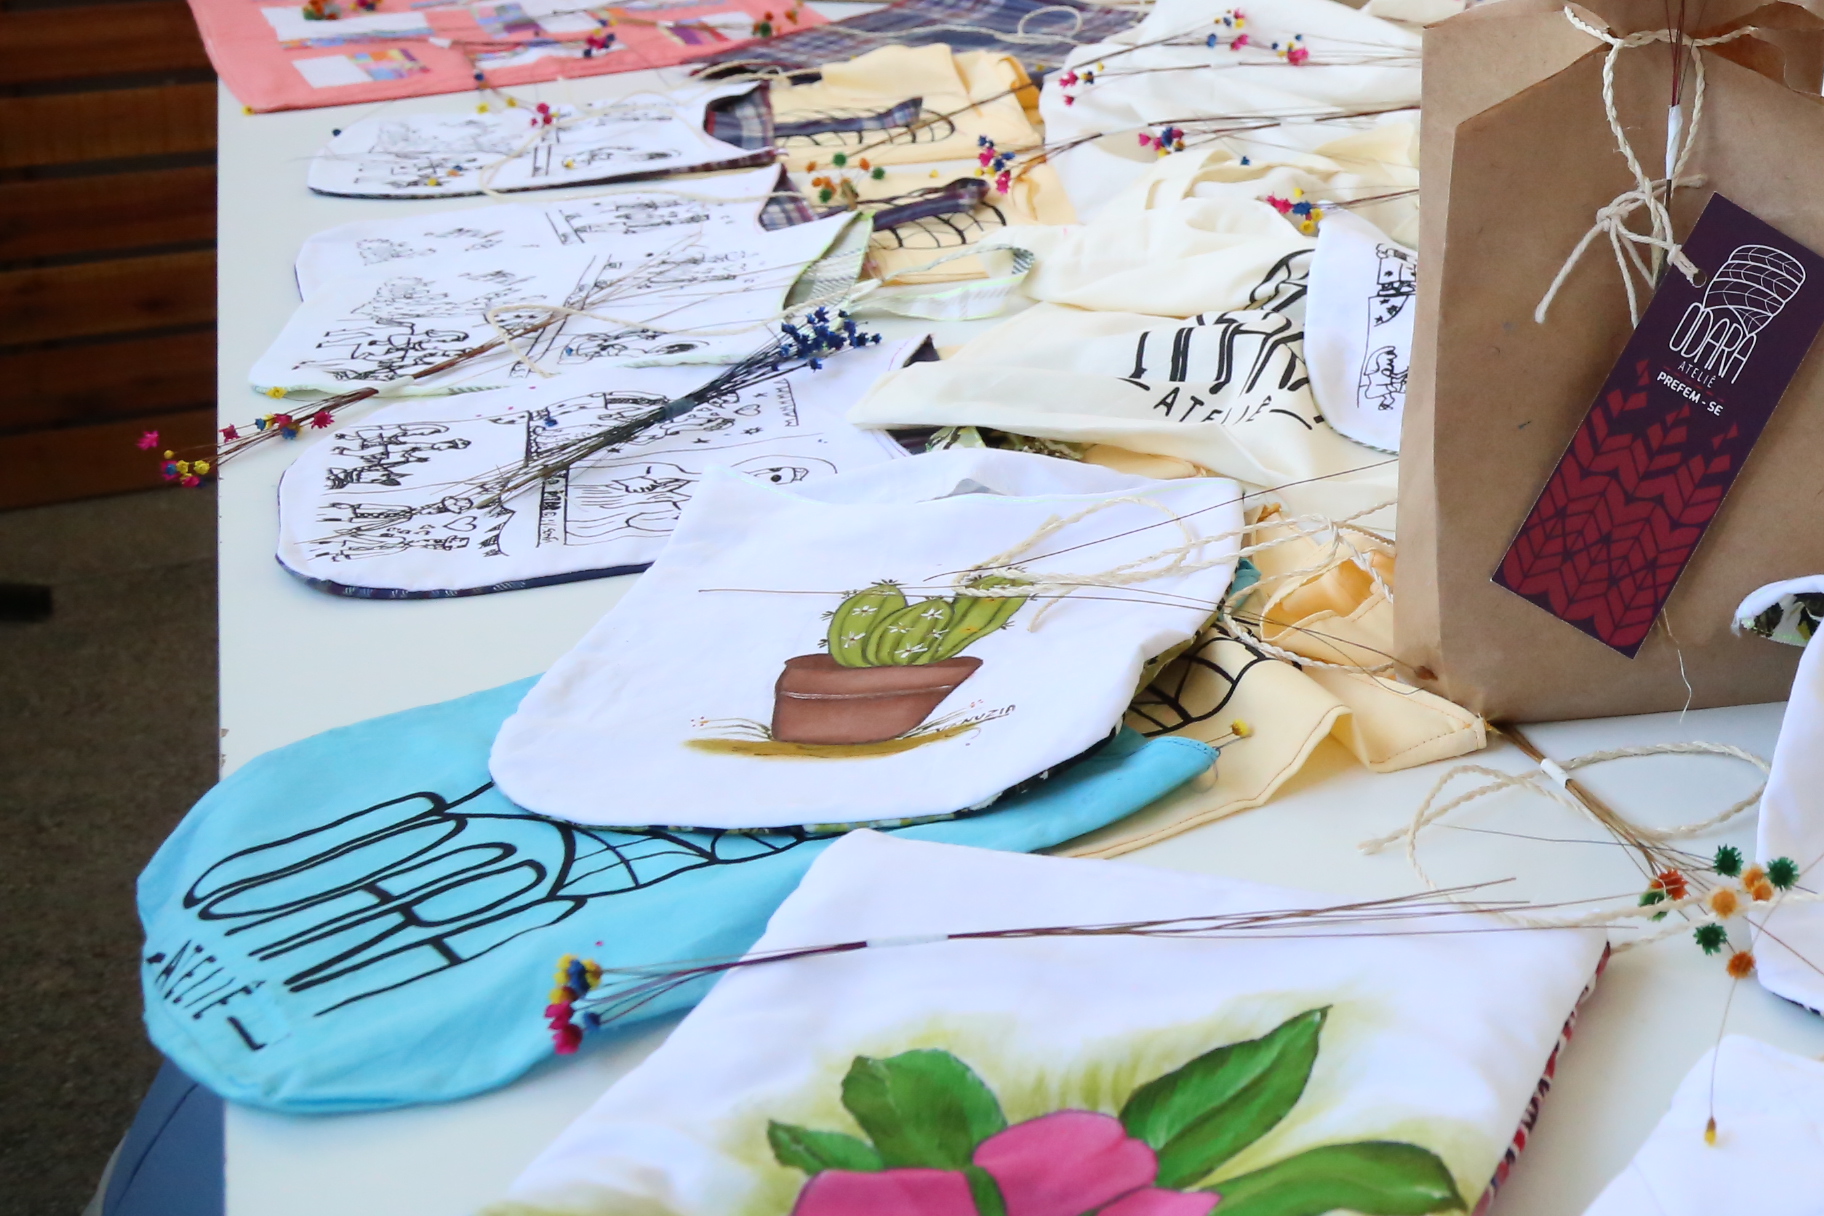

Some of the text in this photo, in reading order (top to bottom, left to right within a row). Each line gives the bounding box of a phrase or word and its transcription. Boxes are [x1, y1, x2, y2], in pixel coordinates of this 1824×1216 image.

[1669, 302, 1757, 384] ODARA
[1656, 371, 1702, 404] PREFEM
[1706, 400, 1724, 416] SE
[1677, 360, 1717, 389] ATELIÊ
